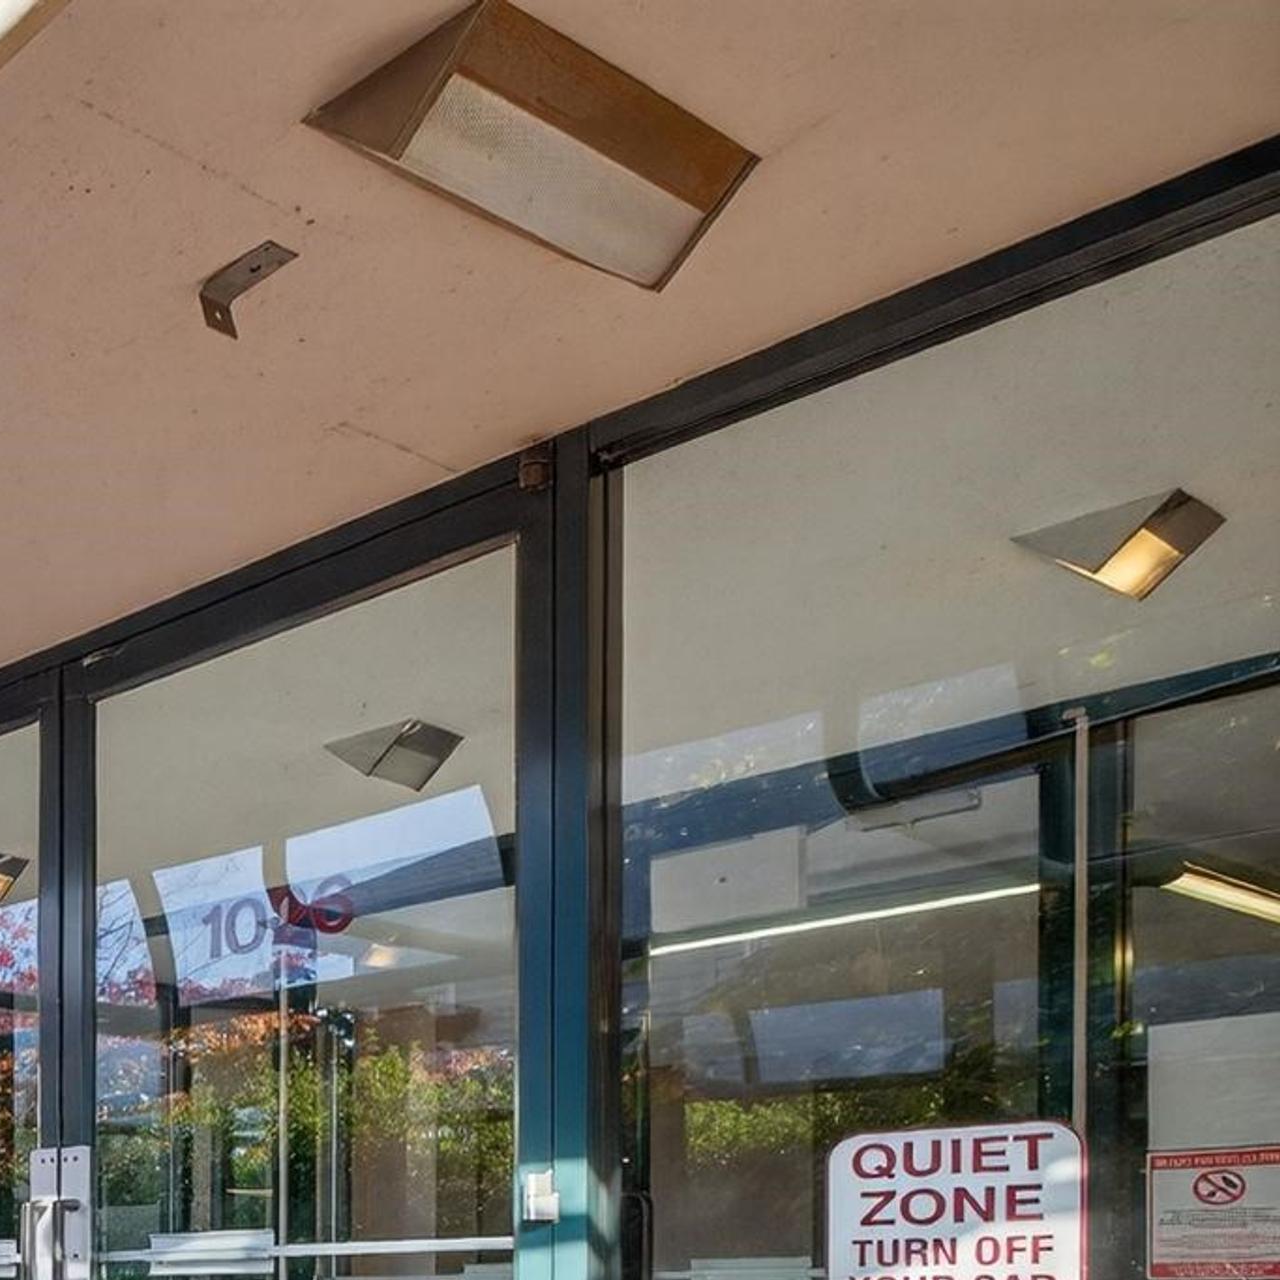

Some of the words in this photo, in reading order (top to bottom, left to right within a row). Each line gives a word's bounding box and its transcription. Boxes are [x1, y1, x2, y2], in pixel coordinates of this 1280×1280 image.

[851, 1132, 1055, 1180] QUIET
[859, 1183, 1045, 1227] ZONE
[851, 1236, 958, 1268] TURN
[974, 1233, 1055, 1266] OFF
